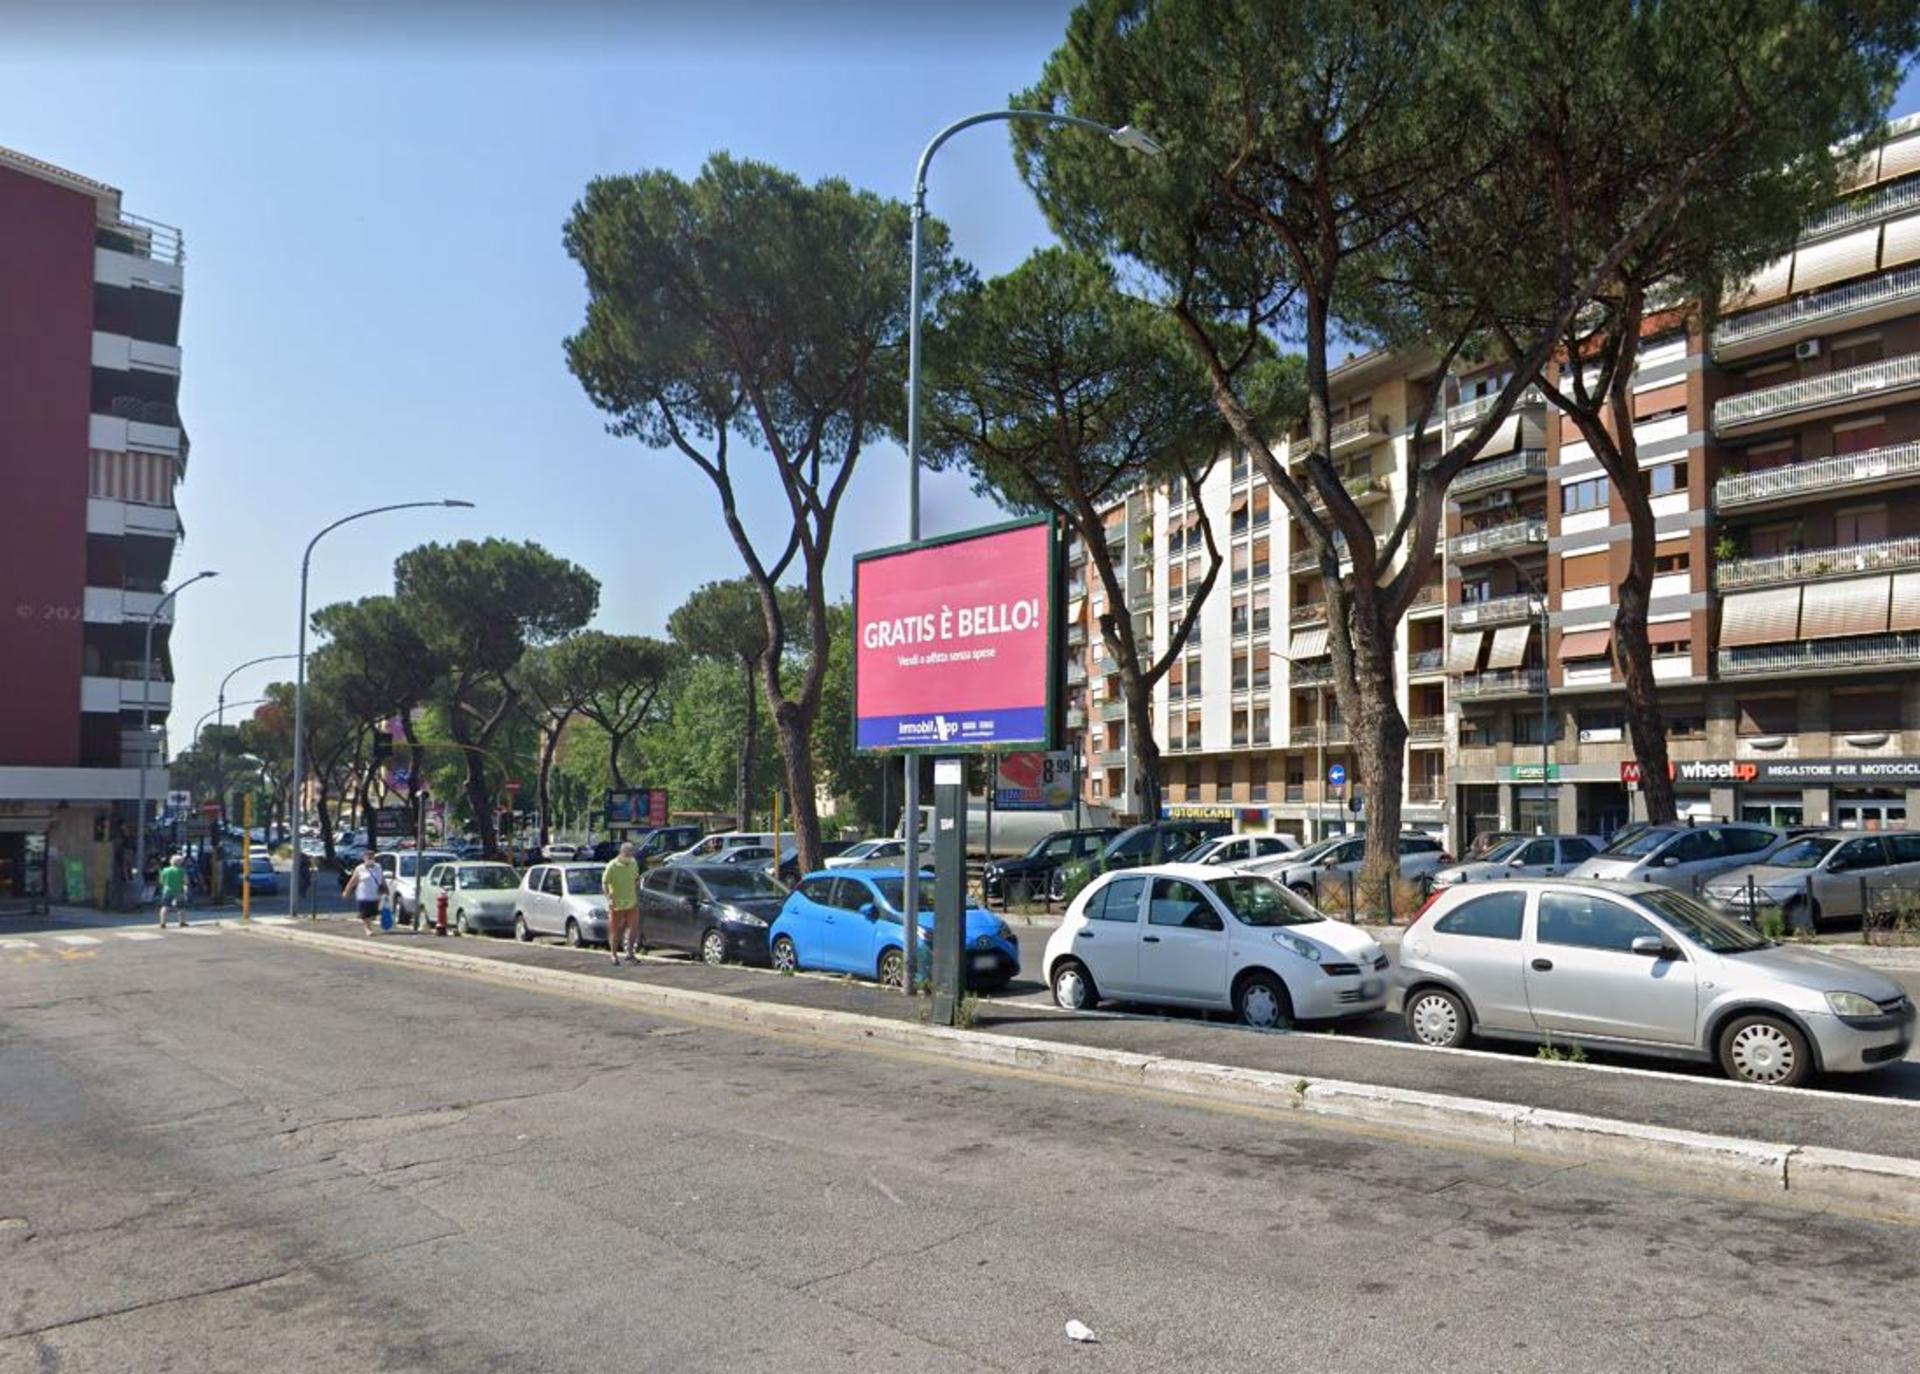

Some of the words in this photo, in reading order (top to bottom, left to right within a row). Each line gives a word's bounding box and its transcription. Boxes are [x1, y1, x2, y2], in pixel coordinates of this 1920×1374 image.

[864, 613, 935, 649] GRATIS
[941, 604, 953, 640] È
[958, 598, 1039, 638] BELLO!
[897, 653, 919, 668] Vendi
[973, 647, 996, 661] spese
[1681, 761, 1757, 781] wheelup
[1767, 765, 1833, 776] MEGASTORE
[1836, 764, 1857, 775] PER
